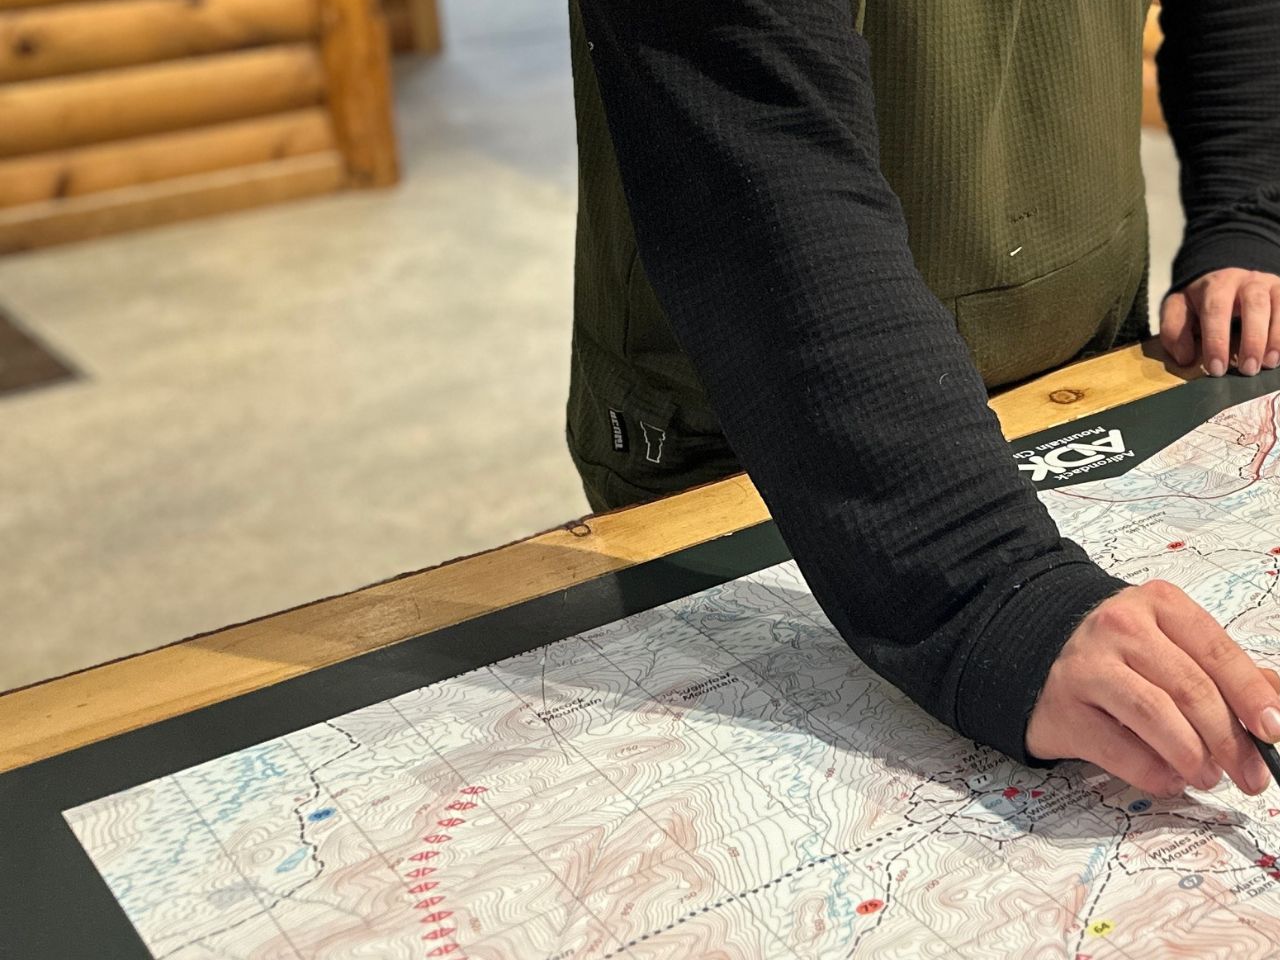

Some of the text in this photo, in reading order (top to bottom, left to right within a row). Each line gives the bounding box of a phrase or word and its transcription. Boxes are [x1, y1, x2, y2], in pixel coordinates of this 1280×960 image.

[1036, 425, 1107, 451] Mountain
[1018, 429, 1126, 482] ADK
[1054, 450, 1135, 481] Adirondack
[683, 677, 739, 701] Mountain
[537, 697, 585, 718] Peacock
[542, 698, 602, 723] Mountain
[1150, 836, 1192, 860] Whales
[1161, 832, 1218, 864] Mountain
[1229, 872, 1268, 895] Marcy
[1249, 879, 1276, 898] Dam
[1094, 922, 1110, 934] 64
